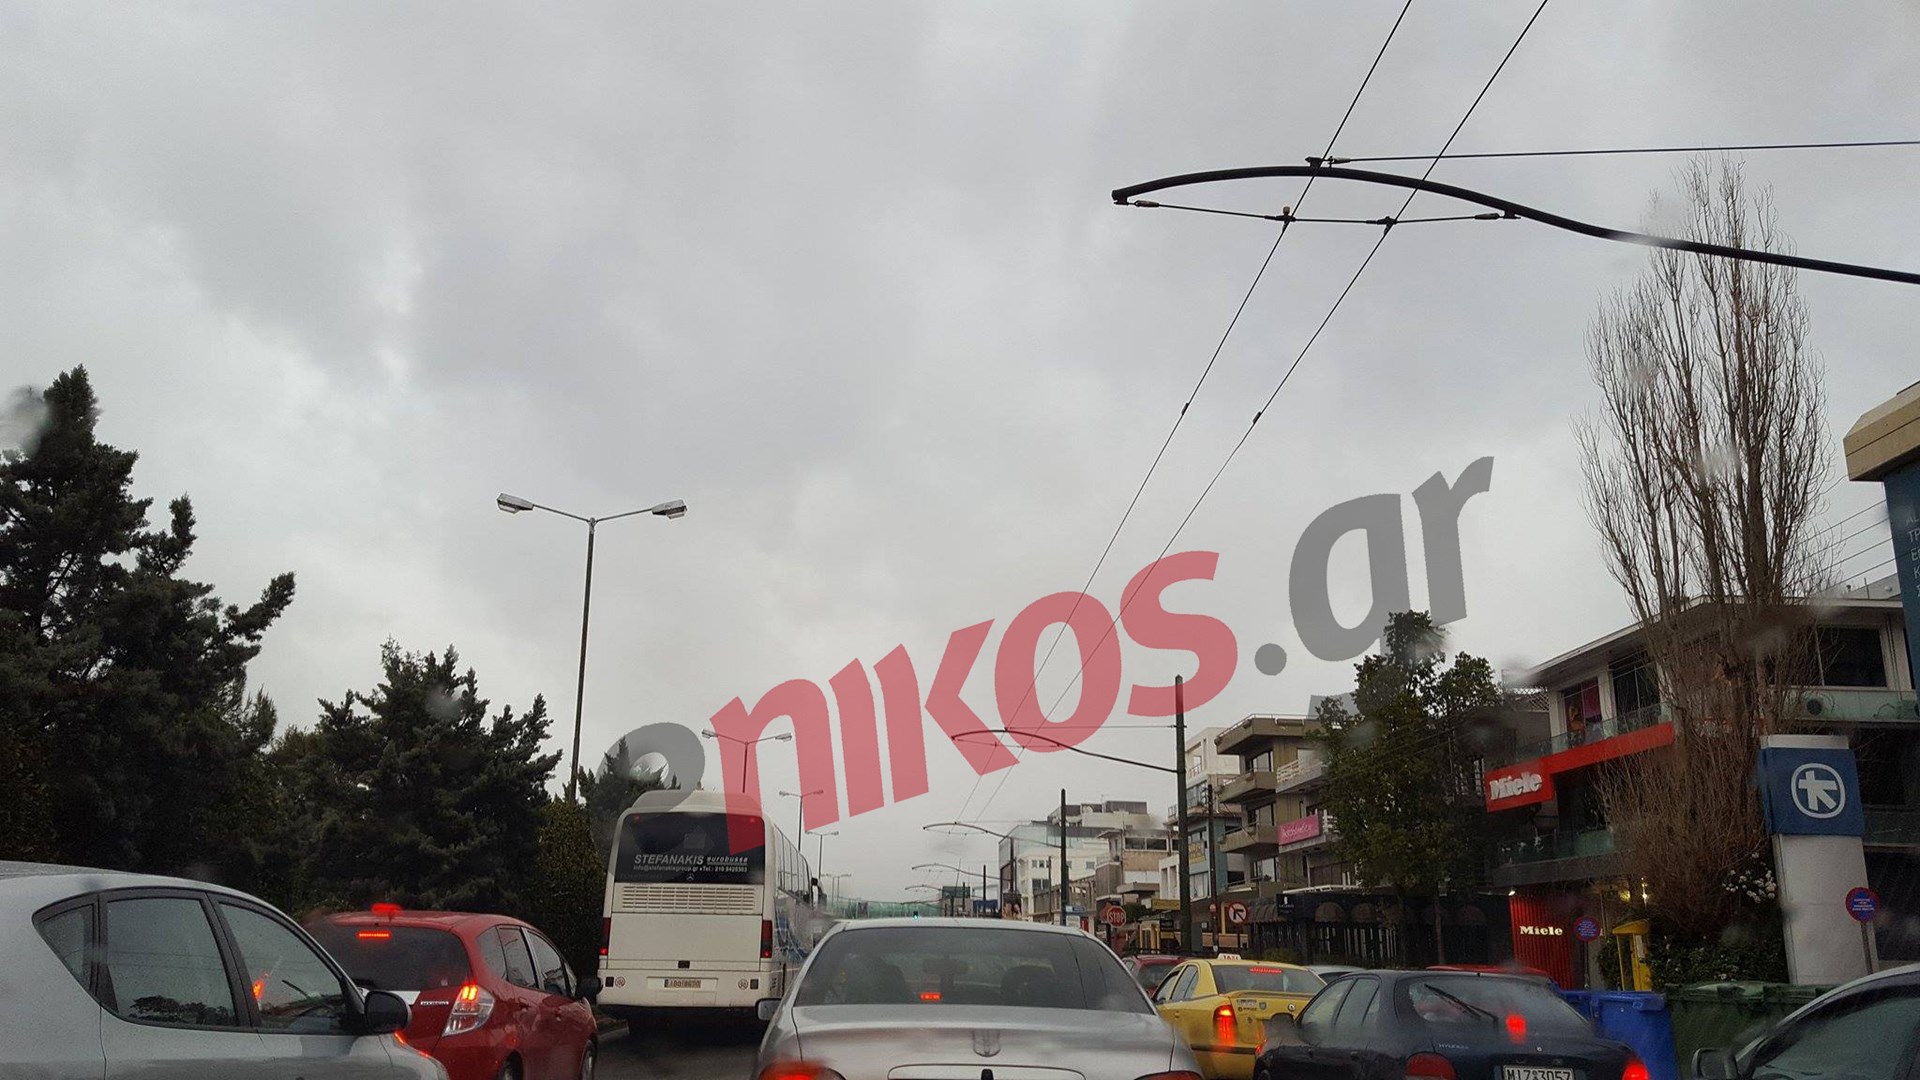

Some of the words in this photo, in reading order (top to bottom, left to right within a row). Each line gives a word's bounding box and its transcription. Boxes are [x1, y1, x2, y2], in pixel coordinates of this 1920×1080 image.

[1489, 772, 1542, 800] Miele
[634, 854, 704, 865] STEFANAKIS
[1108, 911, 1125, 923] STOP
[1520, 926, 1563, 935] Miele
